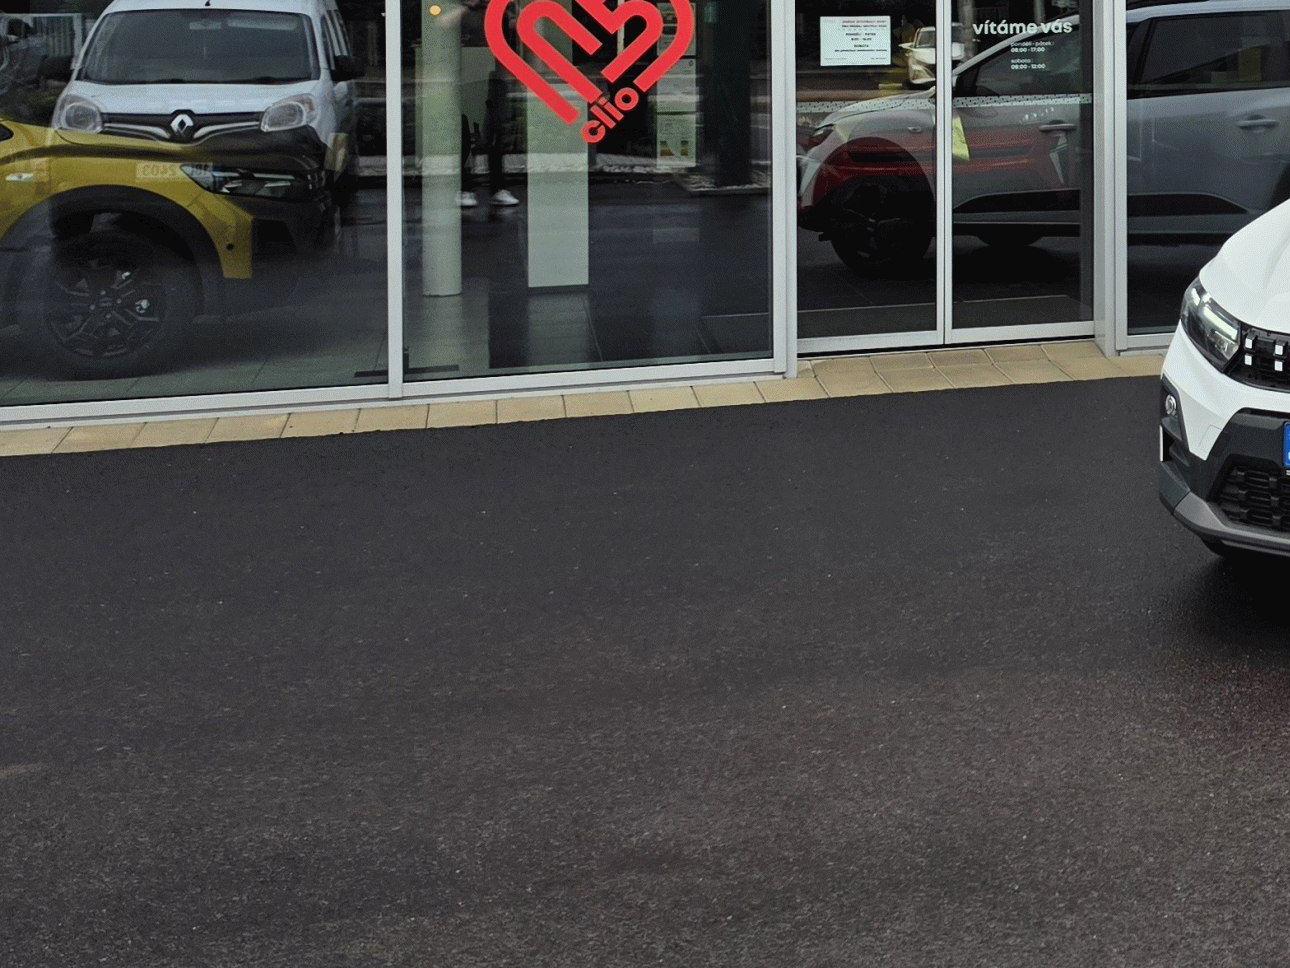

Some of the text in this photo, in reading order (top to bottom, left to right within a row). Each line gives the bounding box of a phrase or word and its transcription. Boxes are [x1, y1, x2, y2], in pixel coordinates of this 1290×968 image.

[972, 18, 1073, 35] vítáme vás
[581, 87, 639, 143] clio
